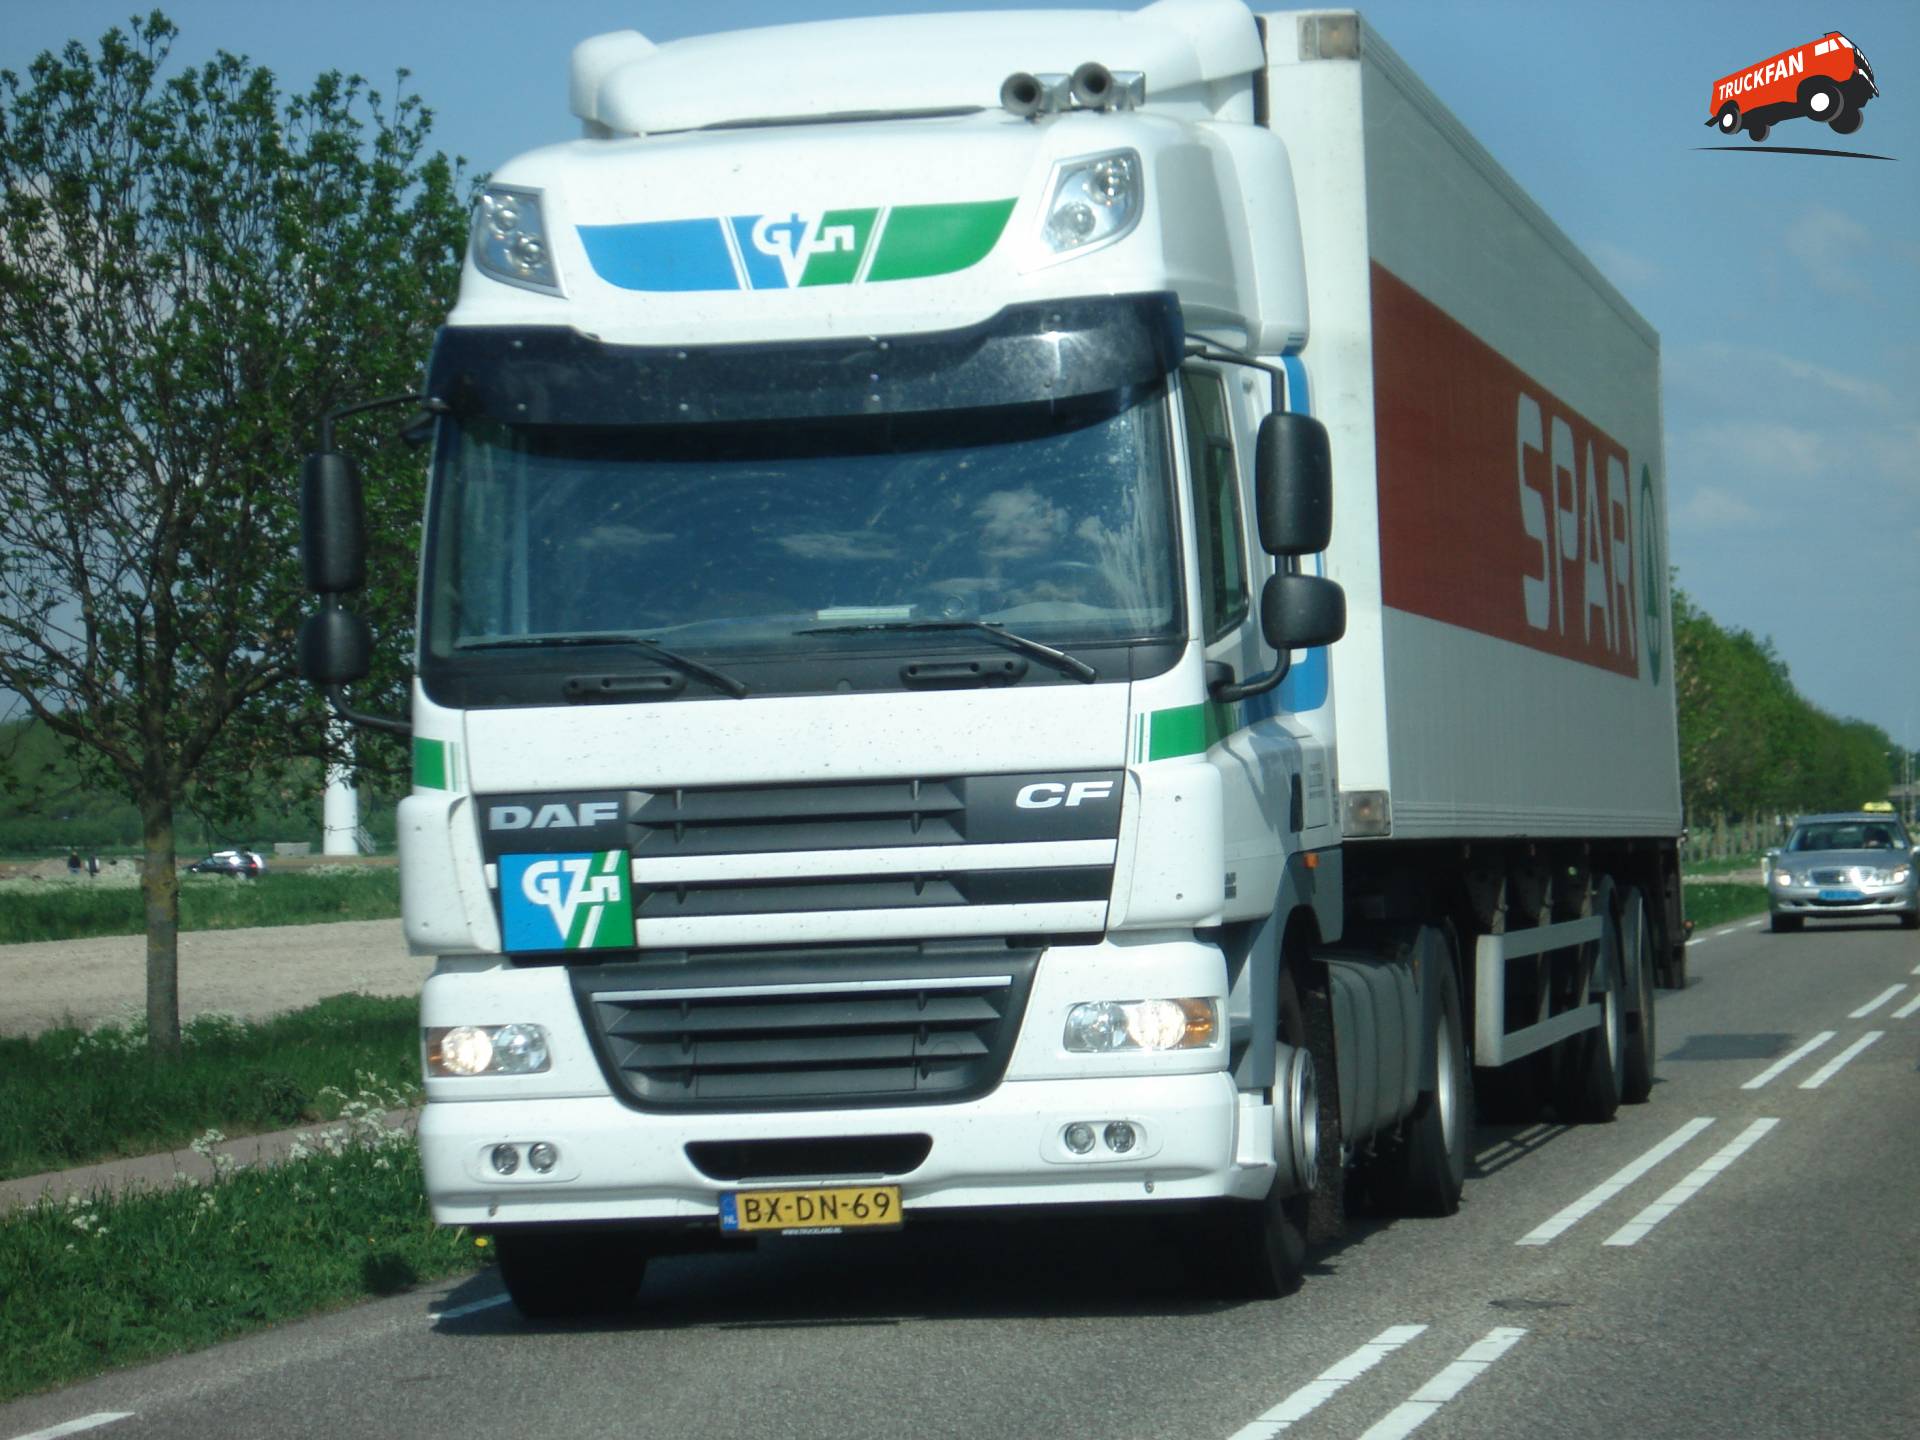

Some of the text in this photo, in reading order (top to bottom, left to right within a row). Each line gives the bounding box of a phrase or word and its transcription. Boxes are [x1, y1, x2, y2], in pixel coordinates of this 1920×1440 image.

[1516, 391, 1636, 660] SPAR
[1016, 781, 1114, 808] CF
[489, 802, 619, 830] DAF
[745, 1192, 890, 1223] BX-DN-69
